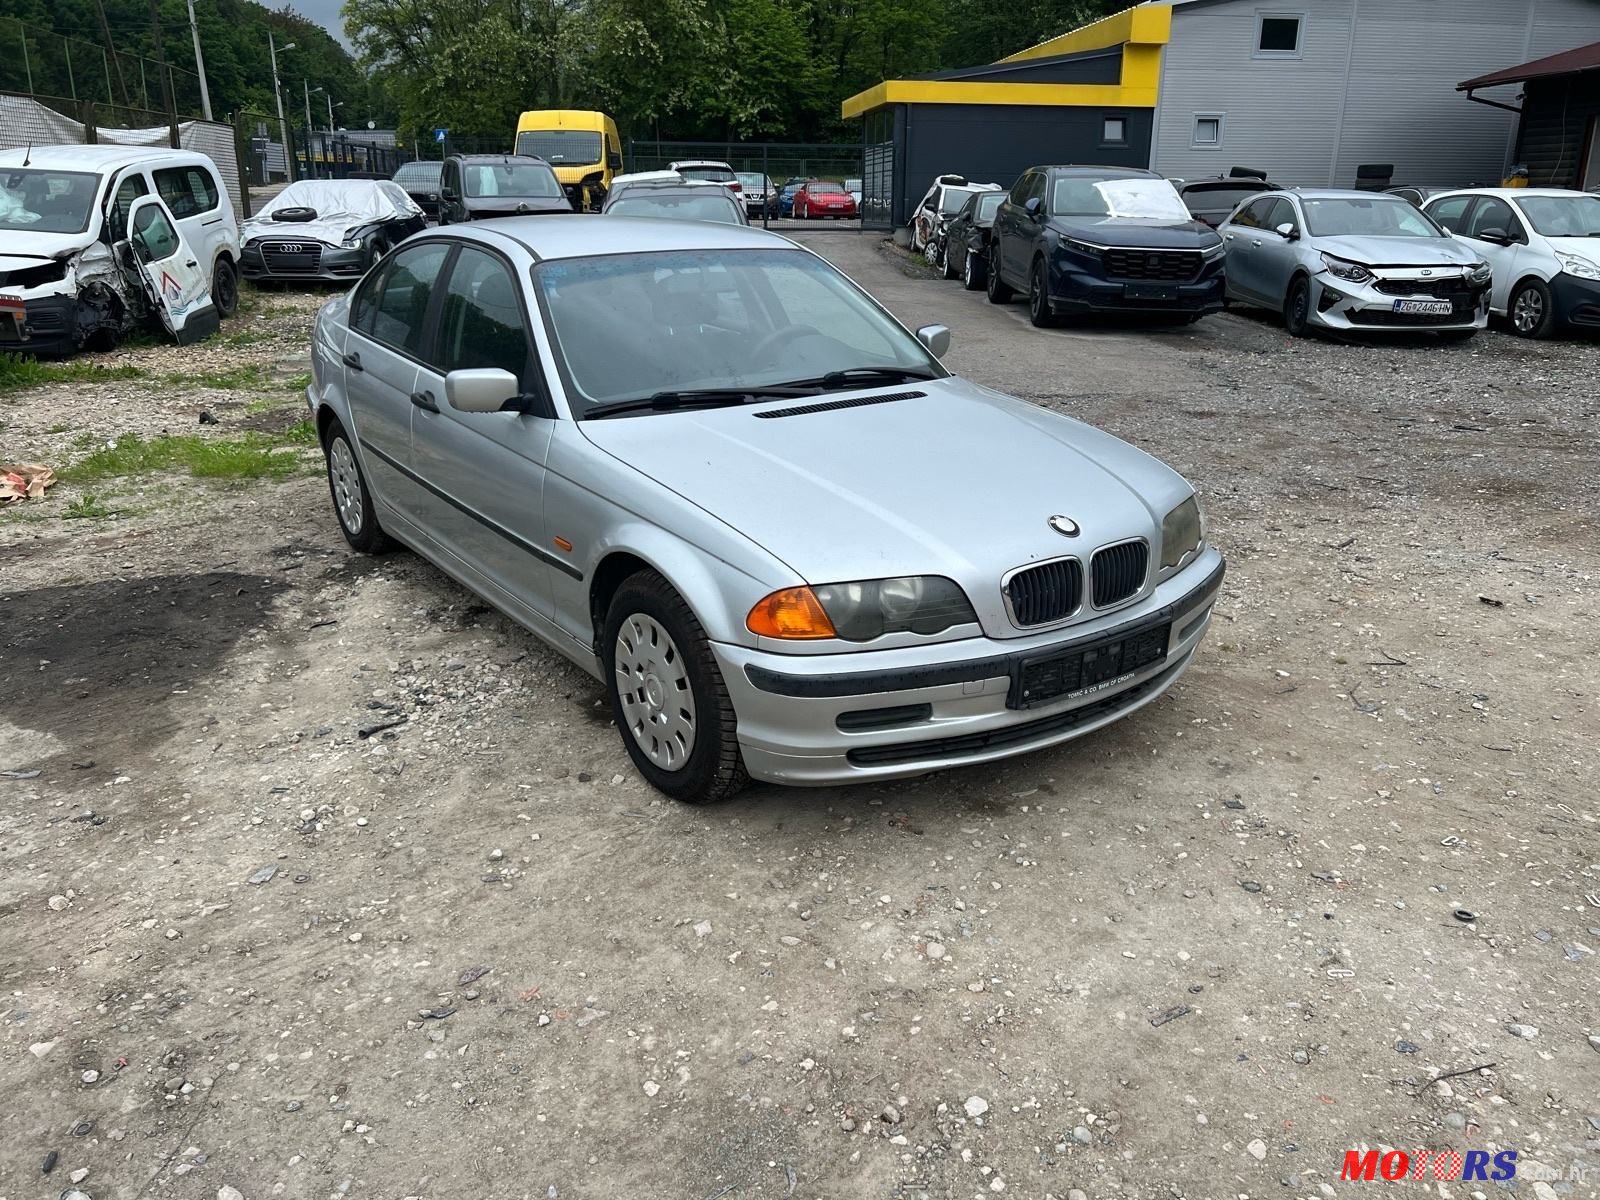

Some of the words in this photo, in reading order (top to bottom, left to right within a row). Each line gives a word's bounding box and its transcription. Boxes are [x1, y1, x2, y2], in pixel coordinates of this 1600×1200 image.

[1401, 301, 1413, 311] ZG
[1098, 681, 1109, 690] BMW
[1118, 673, 1135, 683] CROATIA
